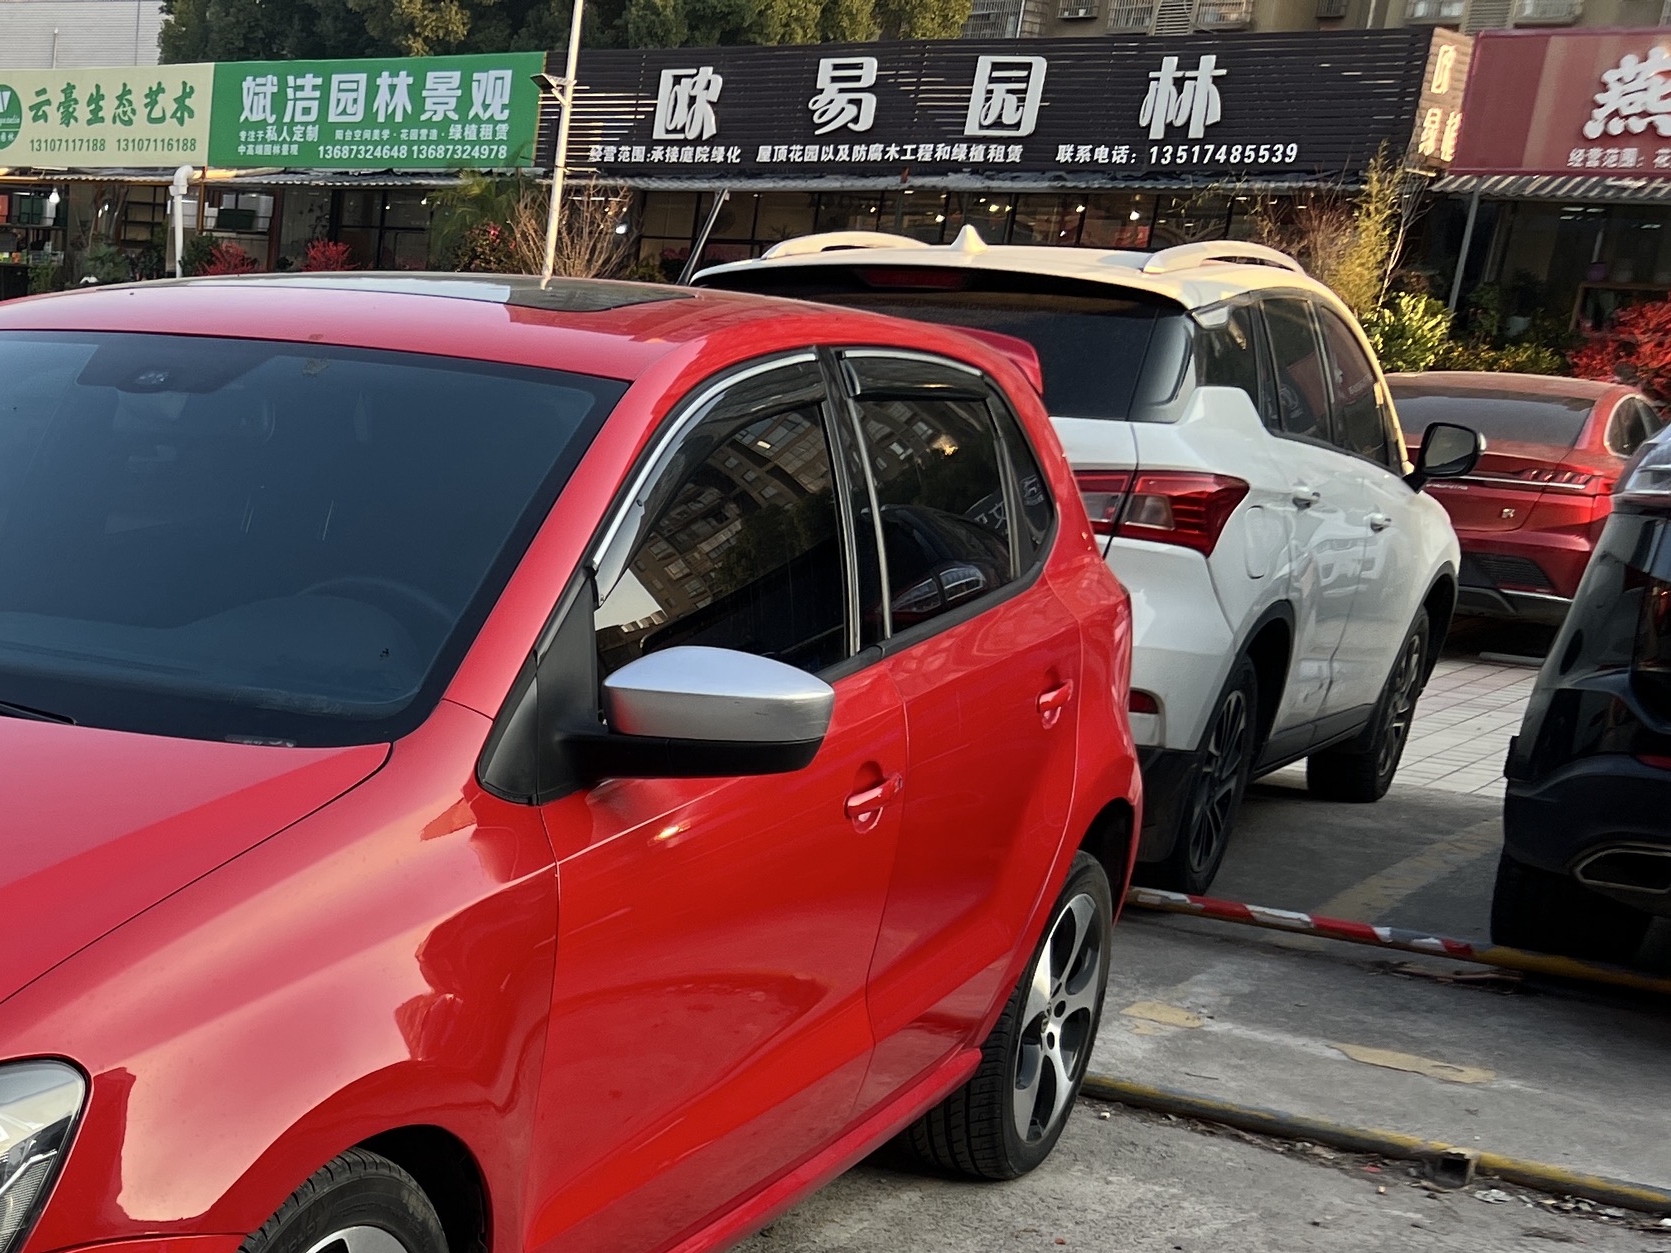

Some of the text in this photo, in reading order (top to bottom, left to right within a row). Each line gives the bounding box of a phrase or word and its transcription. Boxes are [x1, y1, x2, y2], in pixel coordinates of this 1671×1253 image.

[28, 80, 196, 128] 云豪生态艺术
[239, 69, 514, 124] 斌洁园林景观
[652, 54, 1228, 141] 欧易园林
[29, 137, 197, 152] 13107117188 13107116188
[317, 145, 508, 160] 13687324648 13687324978
